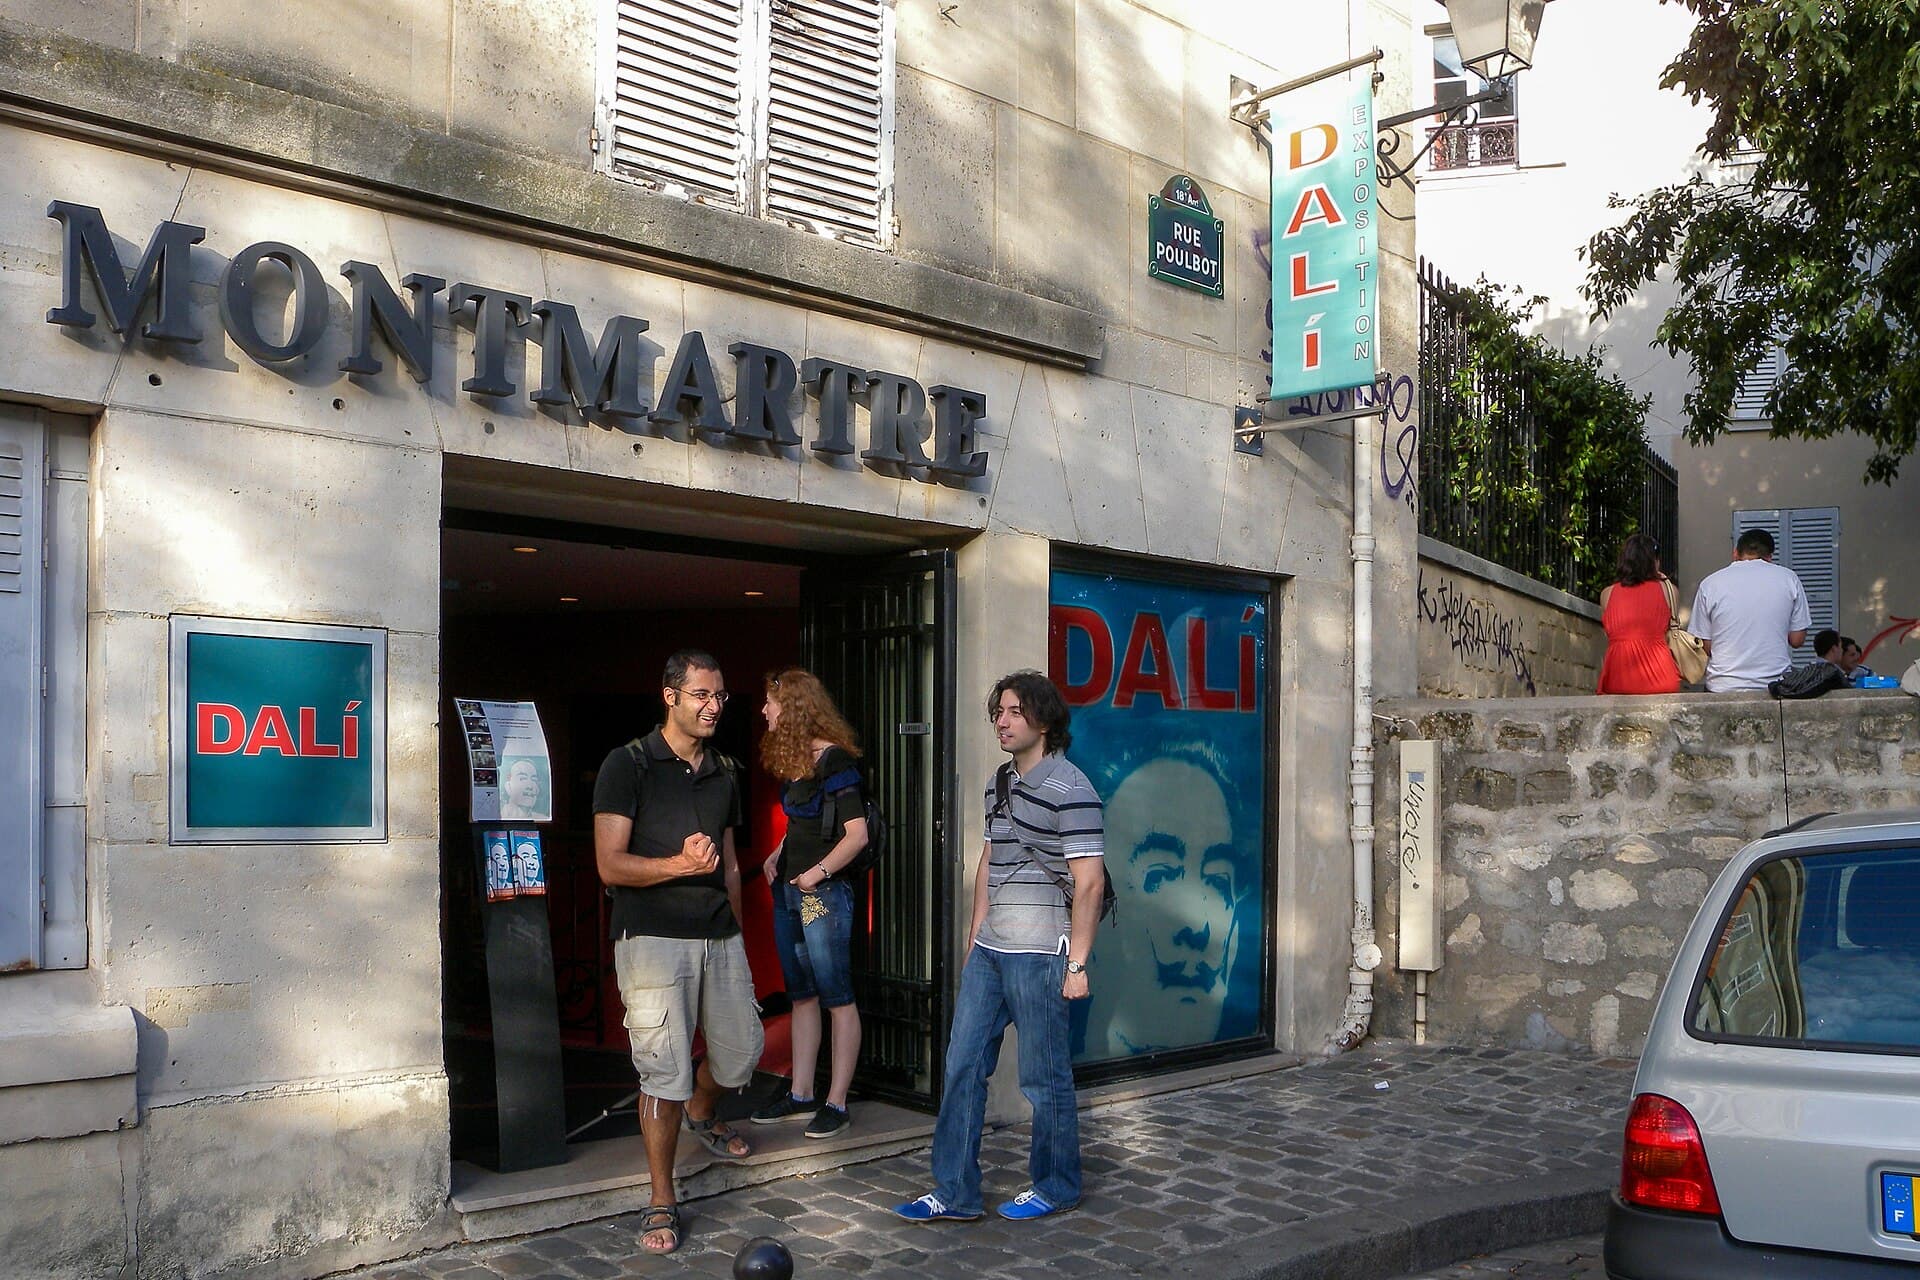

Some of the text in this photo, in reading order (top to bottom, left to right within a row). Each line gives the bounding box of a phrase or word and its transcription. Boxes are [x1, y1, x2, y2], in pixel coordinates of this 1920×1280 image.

[1156, 241, 1218, 278] POULBOT
[1173, 222, 1202, 248] RUE
[1282, 123, 1348, 373] DALÍ
[1352, 104, 1370, 361] EXPOSITION
[46, 200, 989, 478] MONTMARTRE
[1049, 603, 1257, 713] DALÍ
[196, 700, 362, 759] DALÍ
[1894, 1209, 1905, 1223] F
